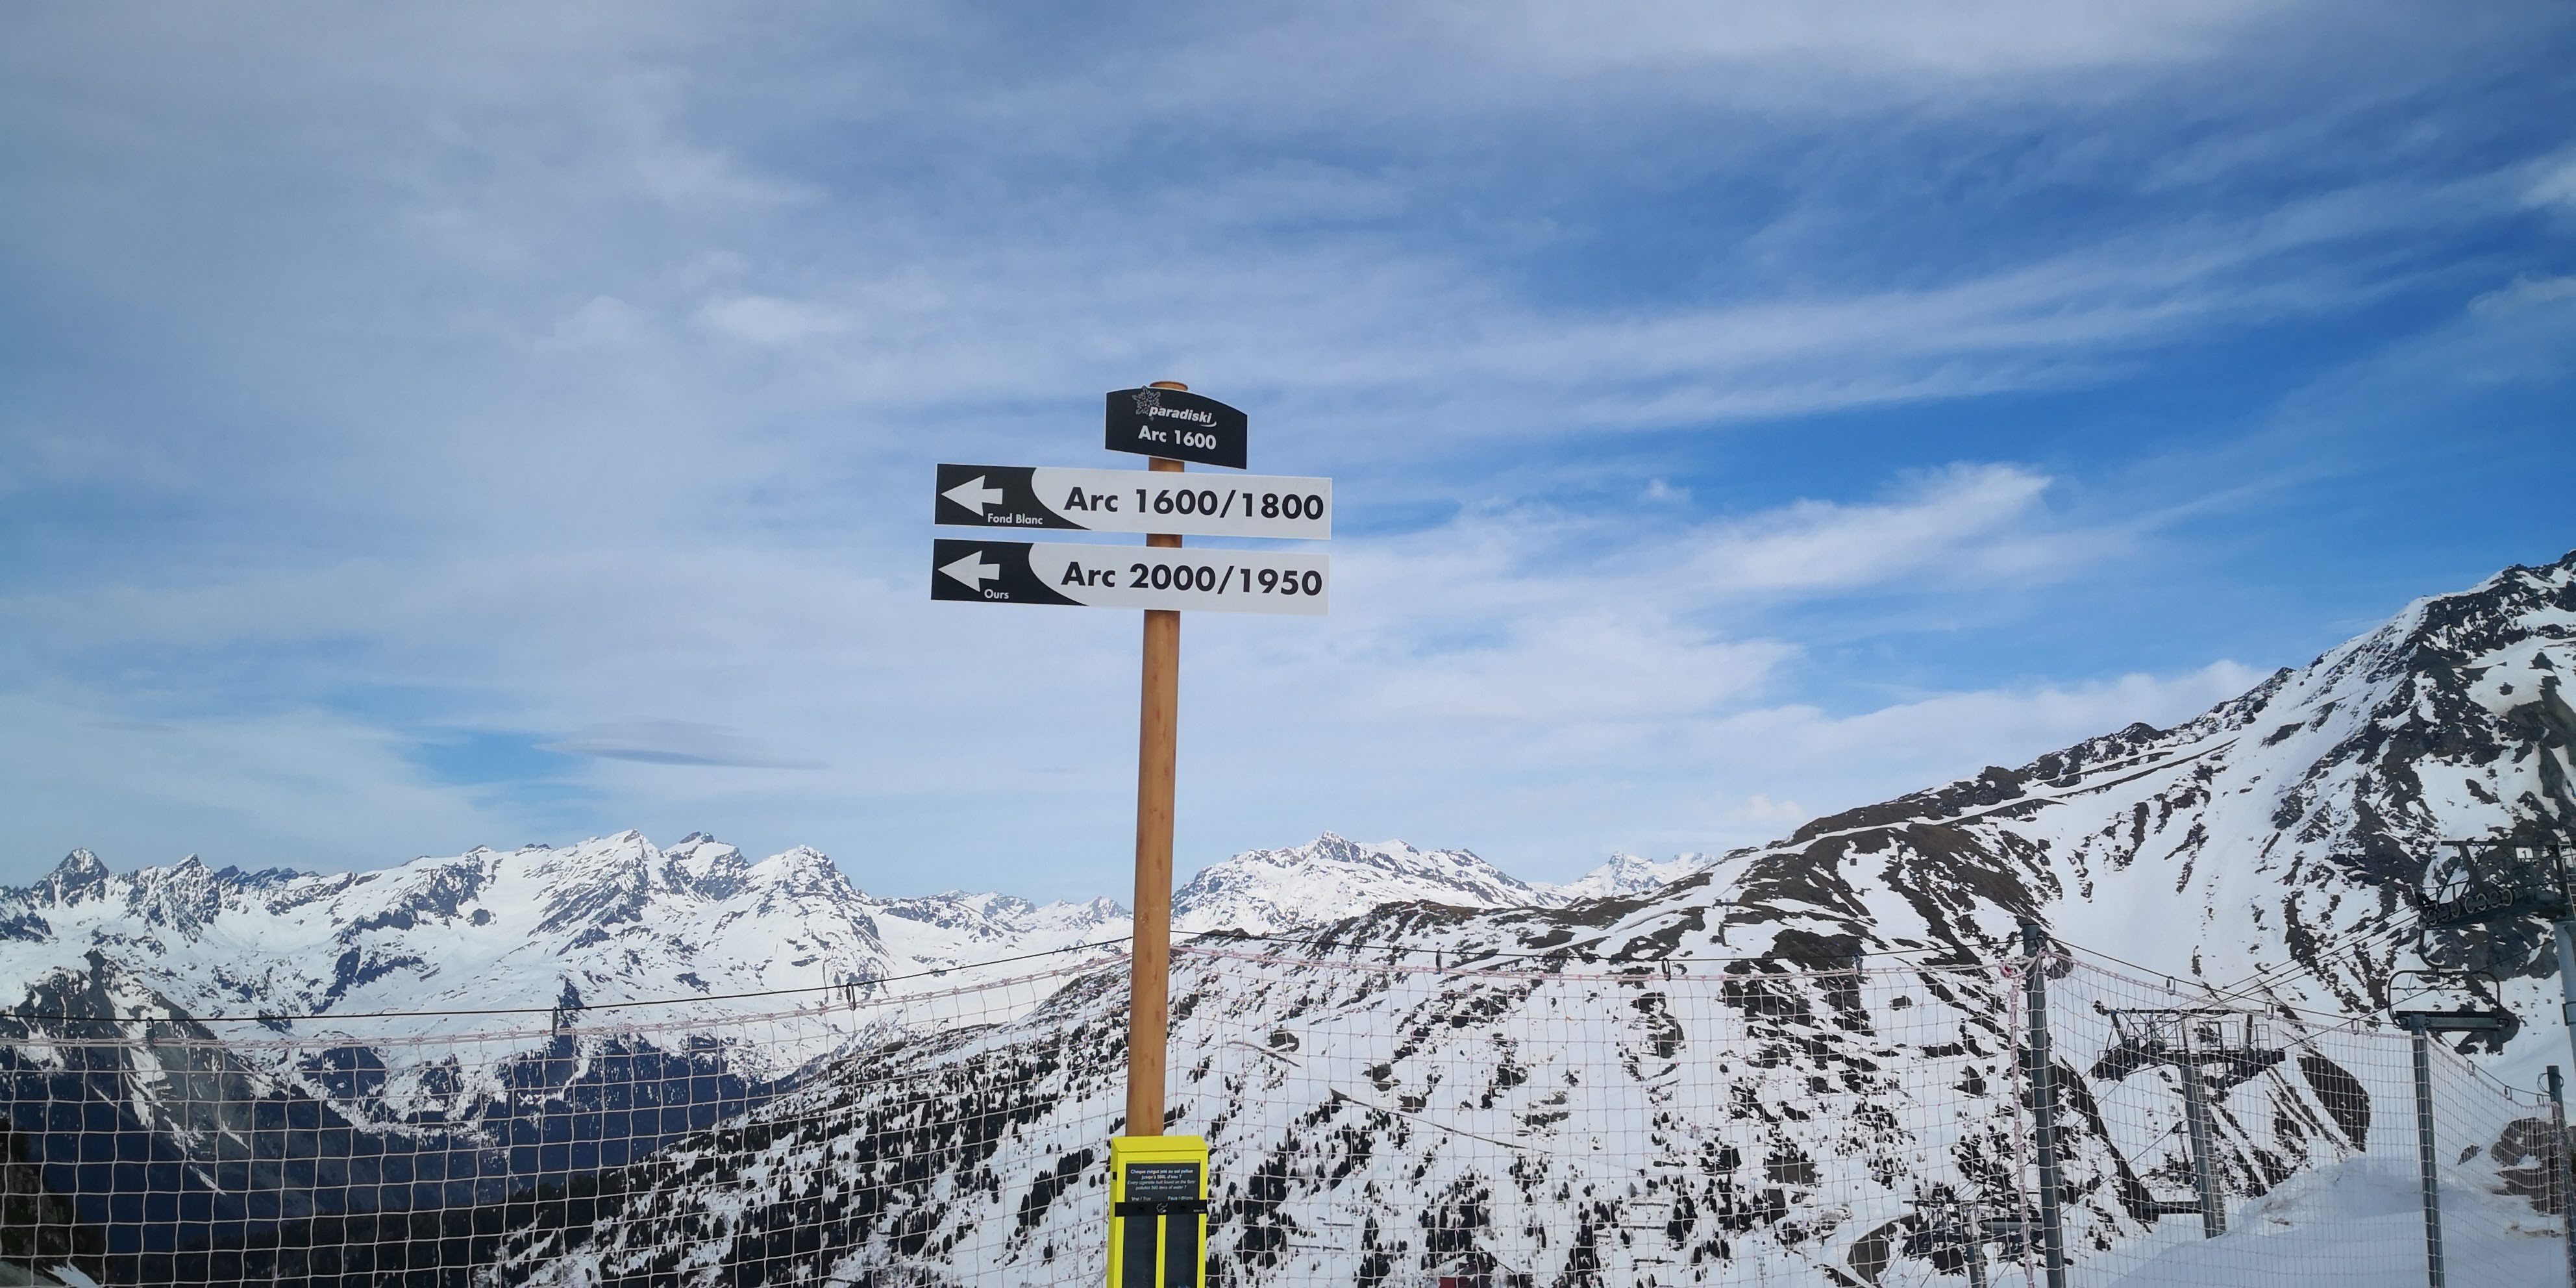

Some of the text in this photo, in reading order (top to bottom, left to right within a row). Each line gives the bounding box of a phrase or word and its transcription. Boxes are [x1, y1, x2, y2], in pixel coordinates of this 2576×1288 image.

[1148, 406, 1213, 424] paradiski
[1138, 425, 1217, 450] Arc 1600
[1063, 486, 1324, 520] Arc 1600/1800
[987, 512, 1043, 525] Fond Blanc
[1061, 561, 1322, 596] Arc 2000/1950
[984, 588, 1009, 600] Ours
